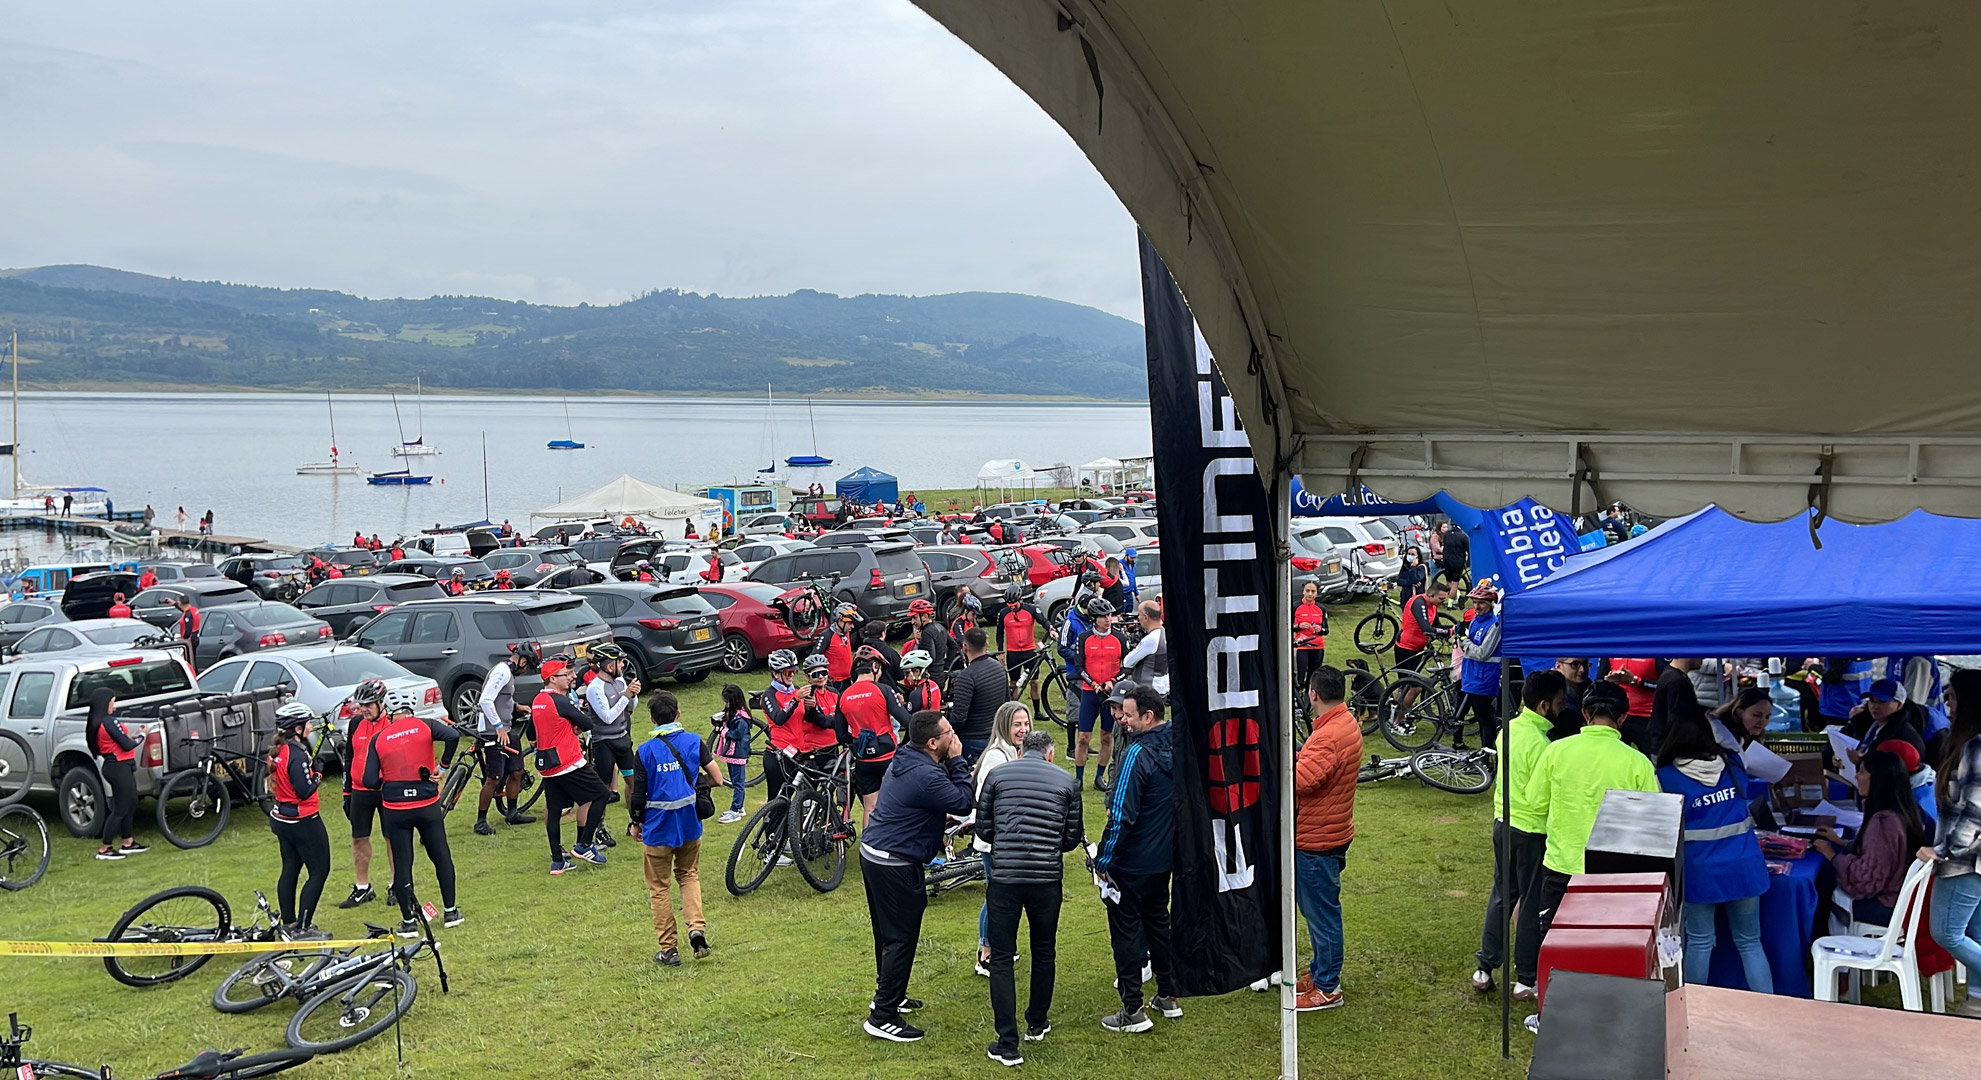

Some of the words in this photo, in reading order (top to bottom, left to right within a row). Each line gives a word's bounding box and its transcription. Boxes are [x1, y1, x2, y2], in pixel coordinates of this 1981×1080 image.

[1500, 509, 1544, 589] mbia
[1530, 505, 1566, 573] cleta
[1193, 318, 1260, 893] FORTINE
[386, 727, 419, 741] FORTINET
[1702, 786, 1736, 806] STAFF
